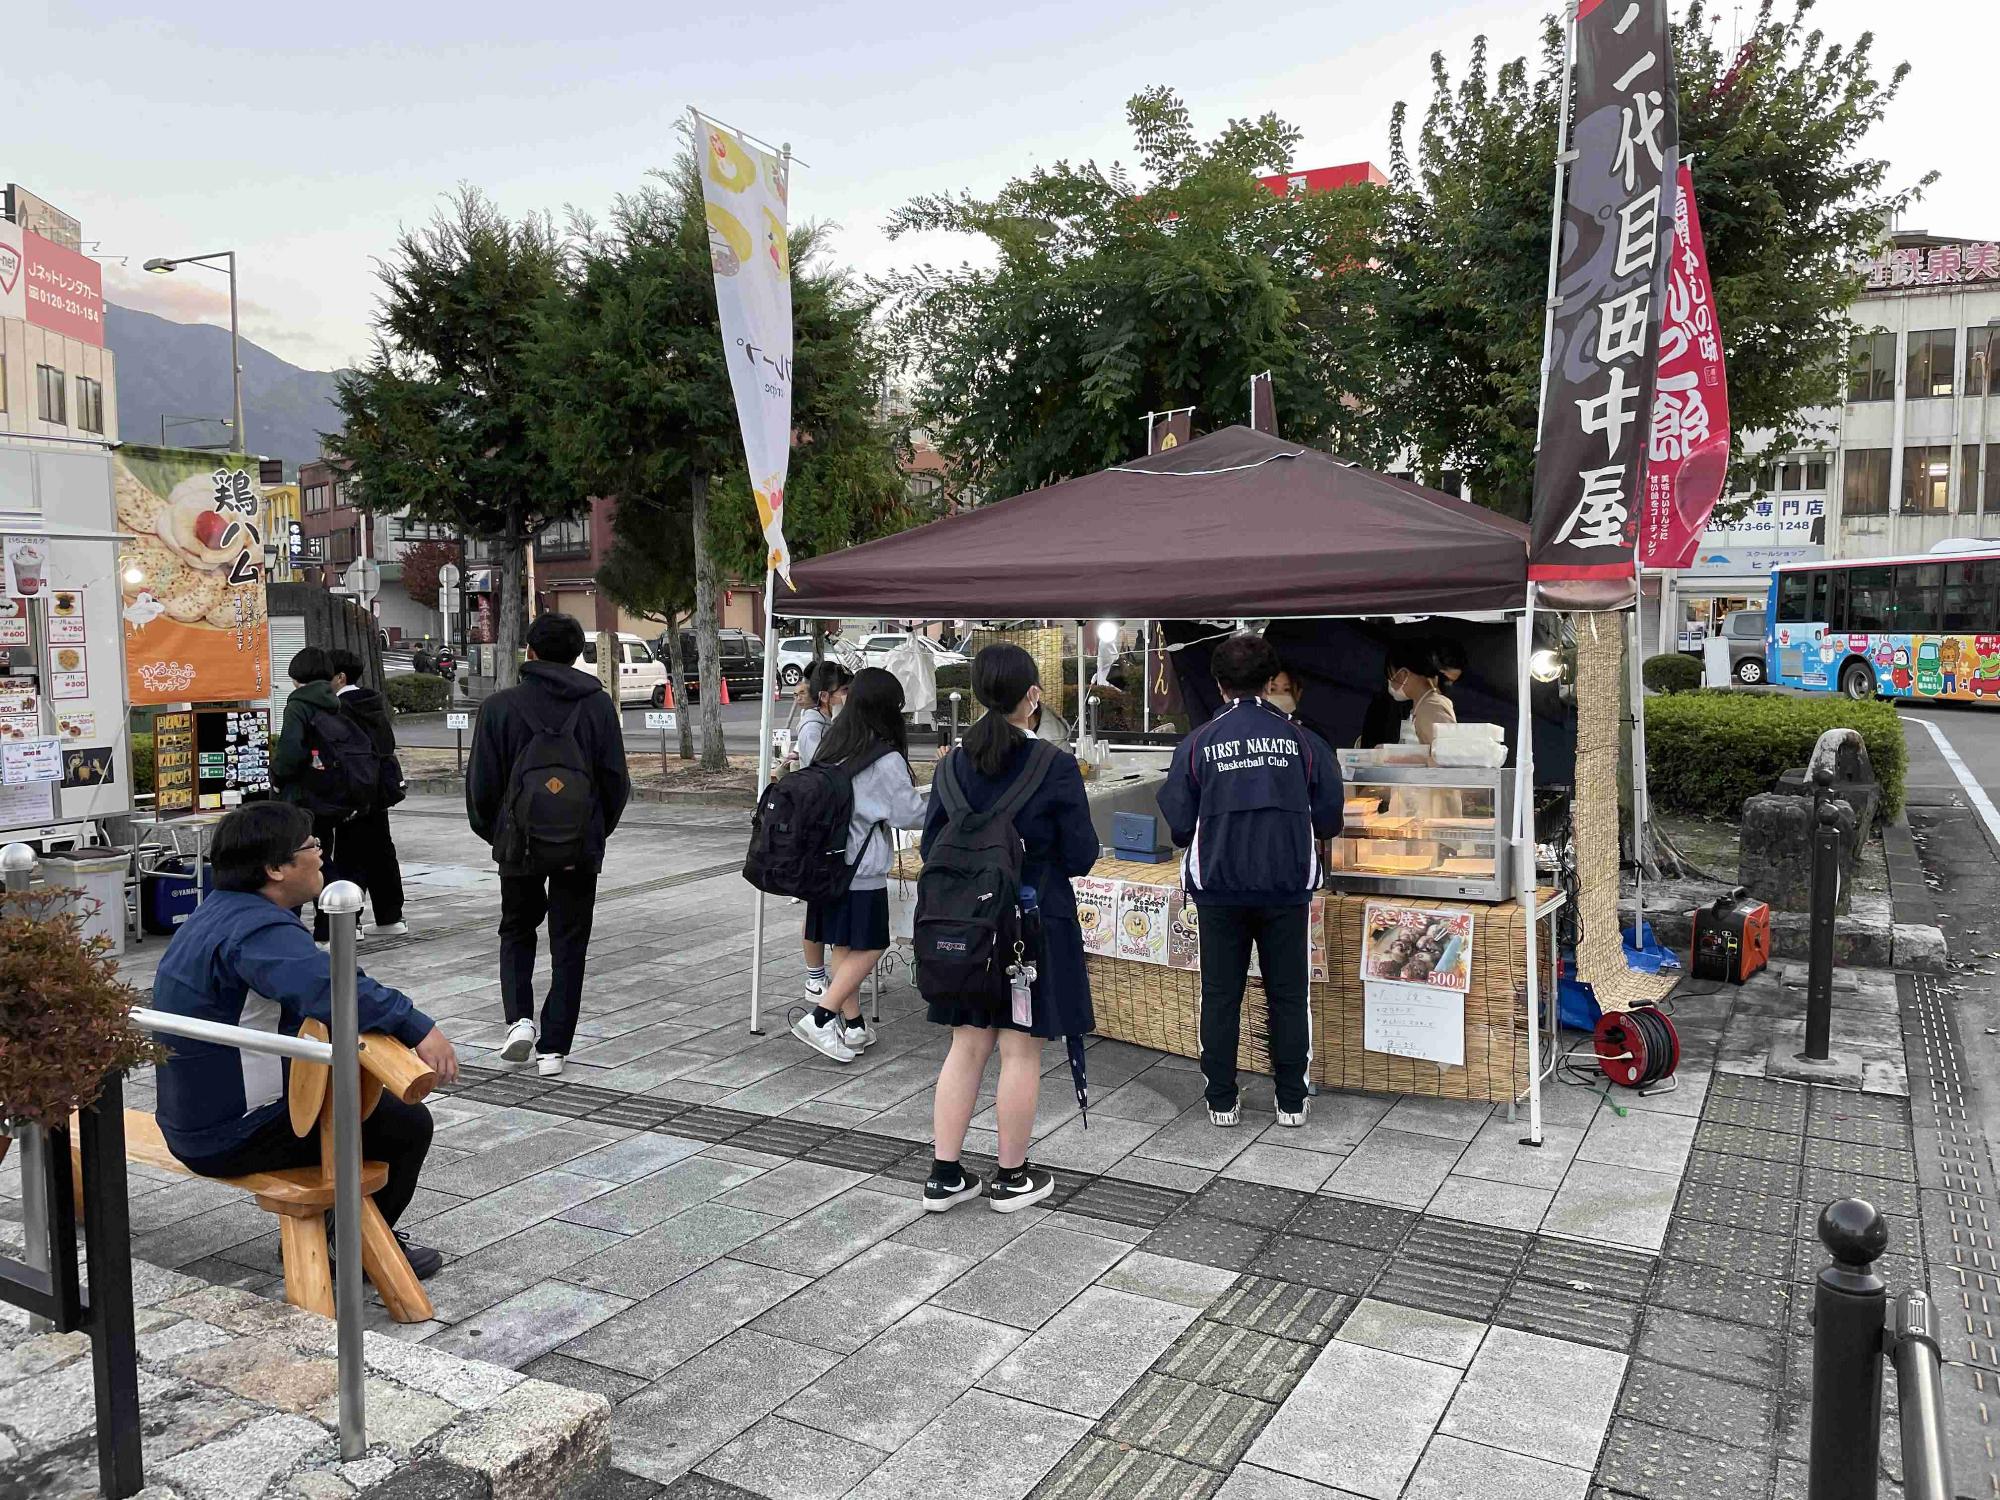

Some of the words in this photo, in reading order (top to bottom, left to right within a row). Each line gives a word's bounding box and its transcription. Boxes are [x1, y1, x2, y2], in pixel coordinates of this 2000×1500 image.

[28, 262, 99, 299] Jネットレンタカー
[211, 468, 260, 585] 鶏ハム
[1204, 741, 1241, 762] FIRST
[1246, 737, 1299, 755] NAKATSU
[1217, 757, 1265, 772] Basketball
[1267, 756, 1289, 767] Club
[179, 888, 198, 896] YAMAH
[1077, 879, 1115, 893] クレープ
[1369, 909, 1428, 929] たこ焼き
[1122, 945, 1150, 957] 500円
[1427, 971, 1466, 989] 500円
